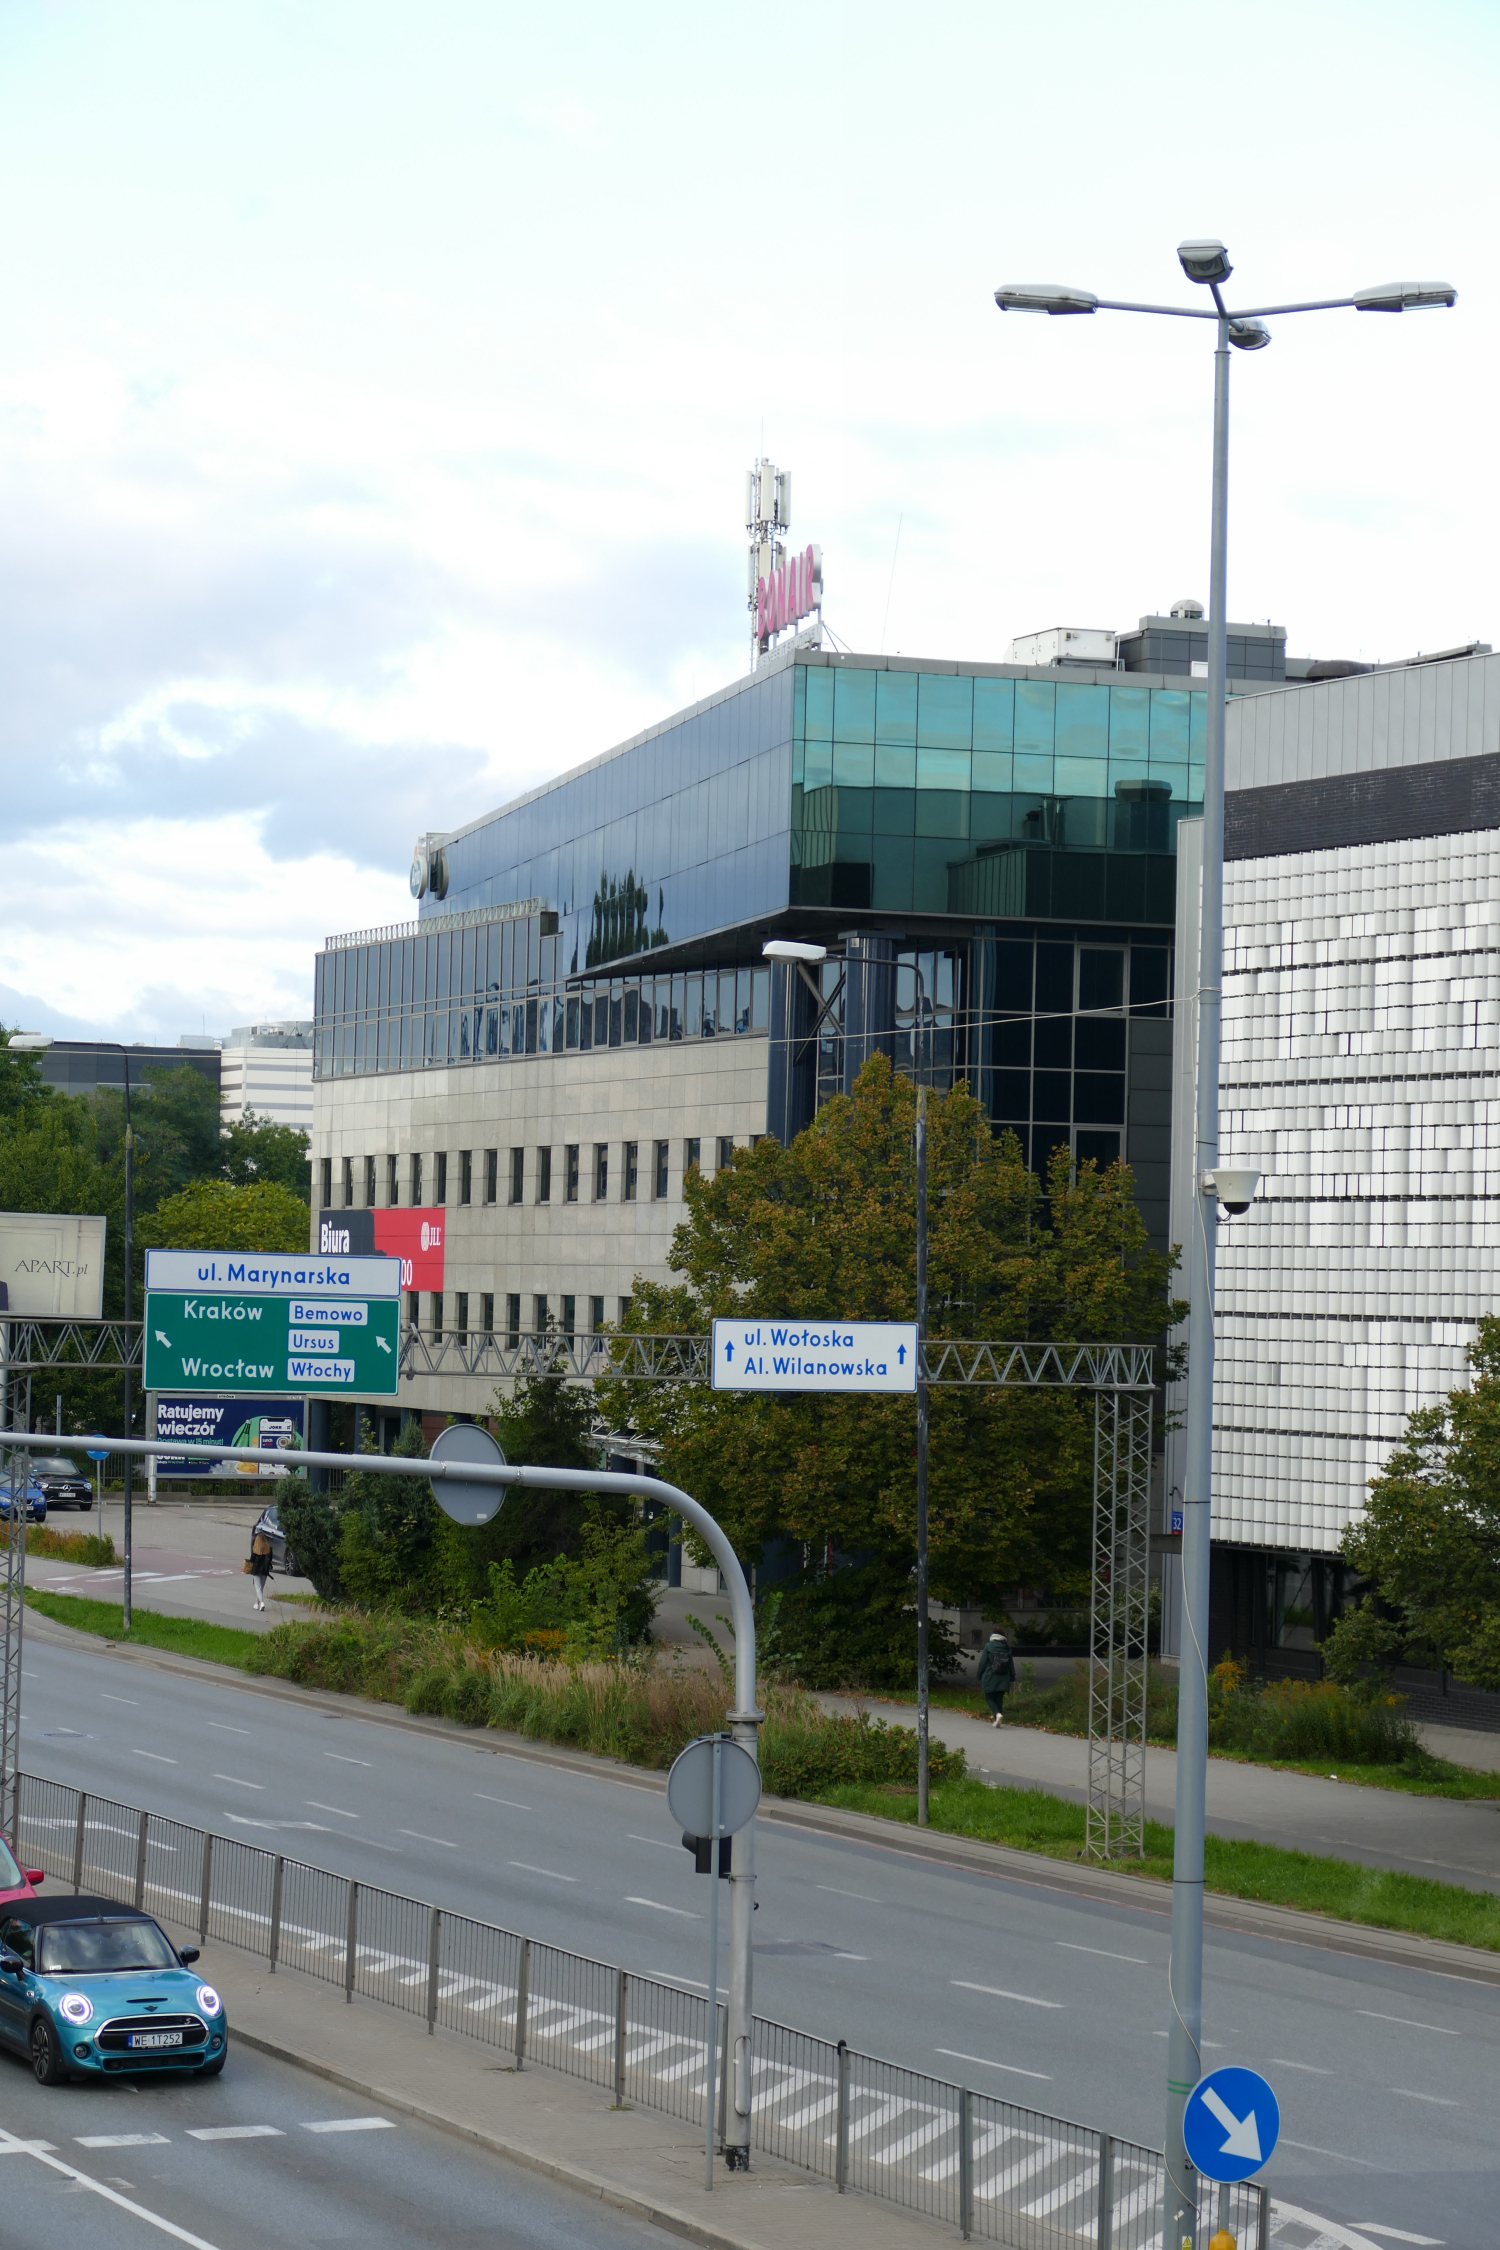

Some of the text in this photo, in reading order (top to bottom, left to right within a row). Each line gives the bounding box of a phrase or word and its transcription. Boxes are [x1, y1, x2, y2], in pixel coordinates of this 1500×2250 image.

[757, 544, 814, 641] BONAIR
[321, 1220, 350, 1253] Biura
[14, 1260, 88, 1277] APART.pl
[198, 1263, 350, 1288] ul. Marynarska
[184, 1299, 263, 1321] Kraków
[294, 1305, 363, 1321] Bemowo
[293, 1333, 334, 1349] Ursus
[744, 1328, 854, 1347] ul. Wołoska
[181, 1357, 274, 1378] Wrocław
[291, 1361, 351, 1382] Włochy
[744, 1357, 887, 1376] Al. Wilanowska
[158, 1404, 224, 1422] Ratujemy
[157, 1420, 216, 1436] wieczór
[1173, 1517, 1182, 1530] 32
[134, 2033, 180, 2046] WE 1T252
